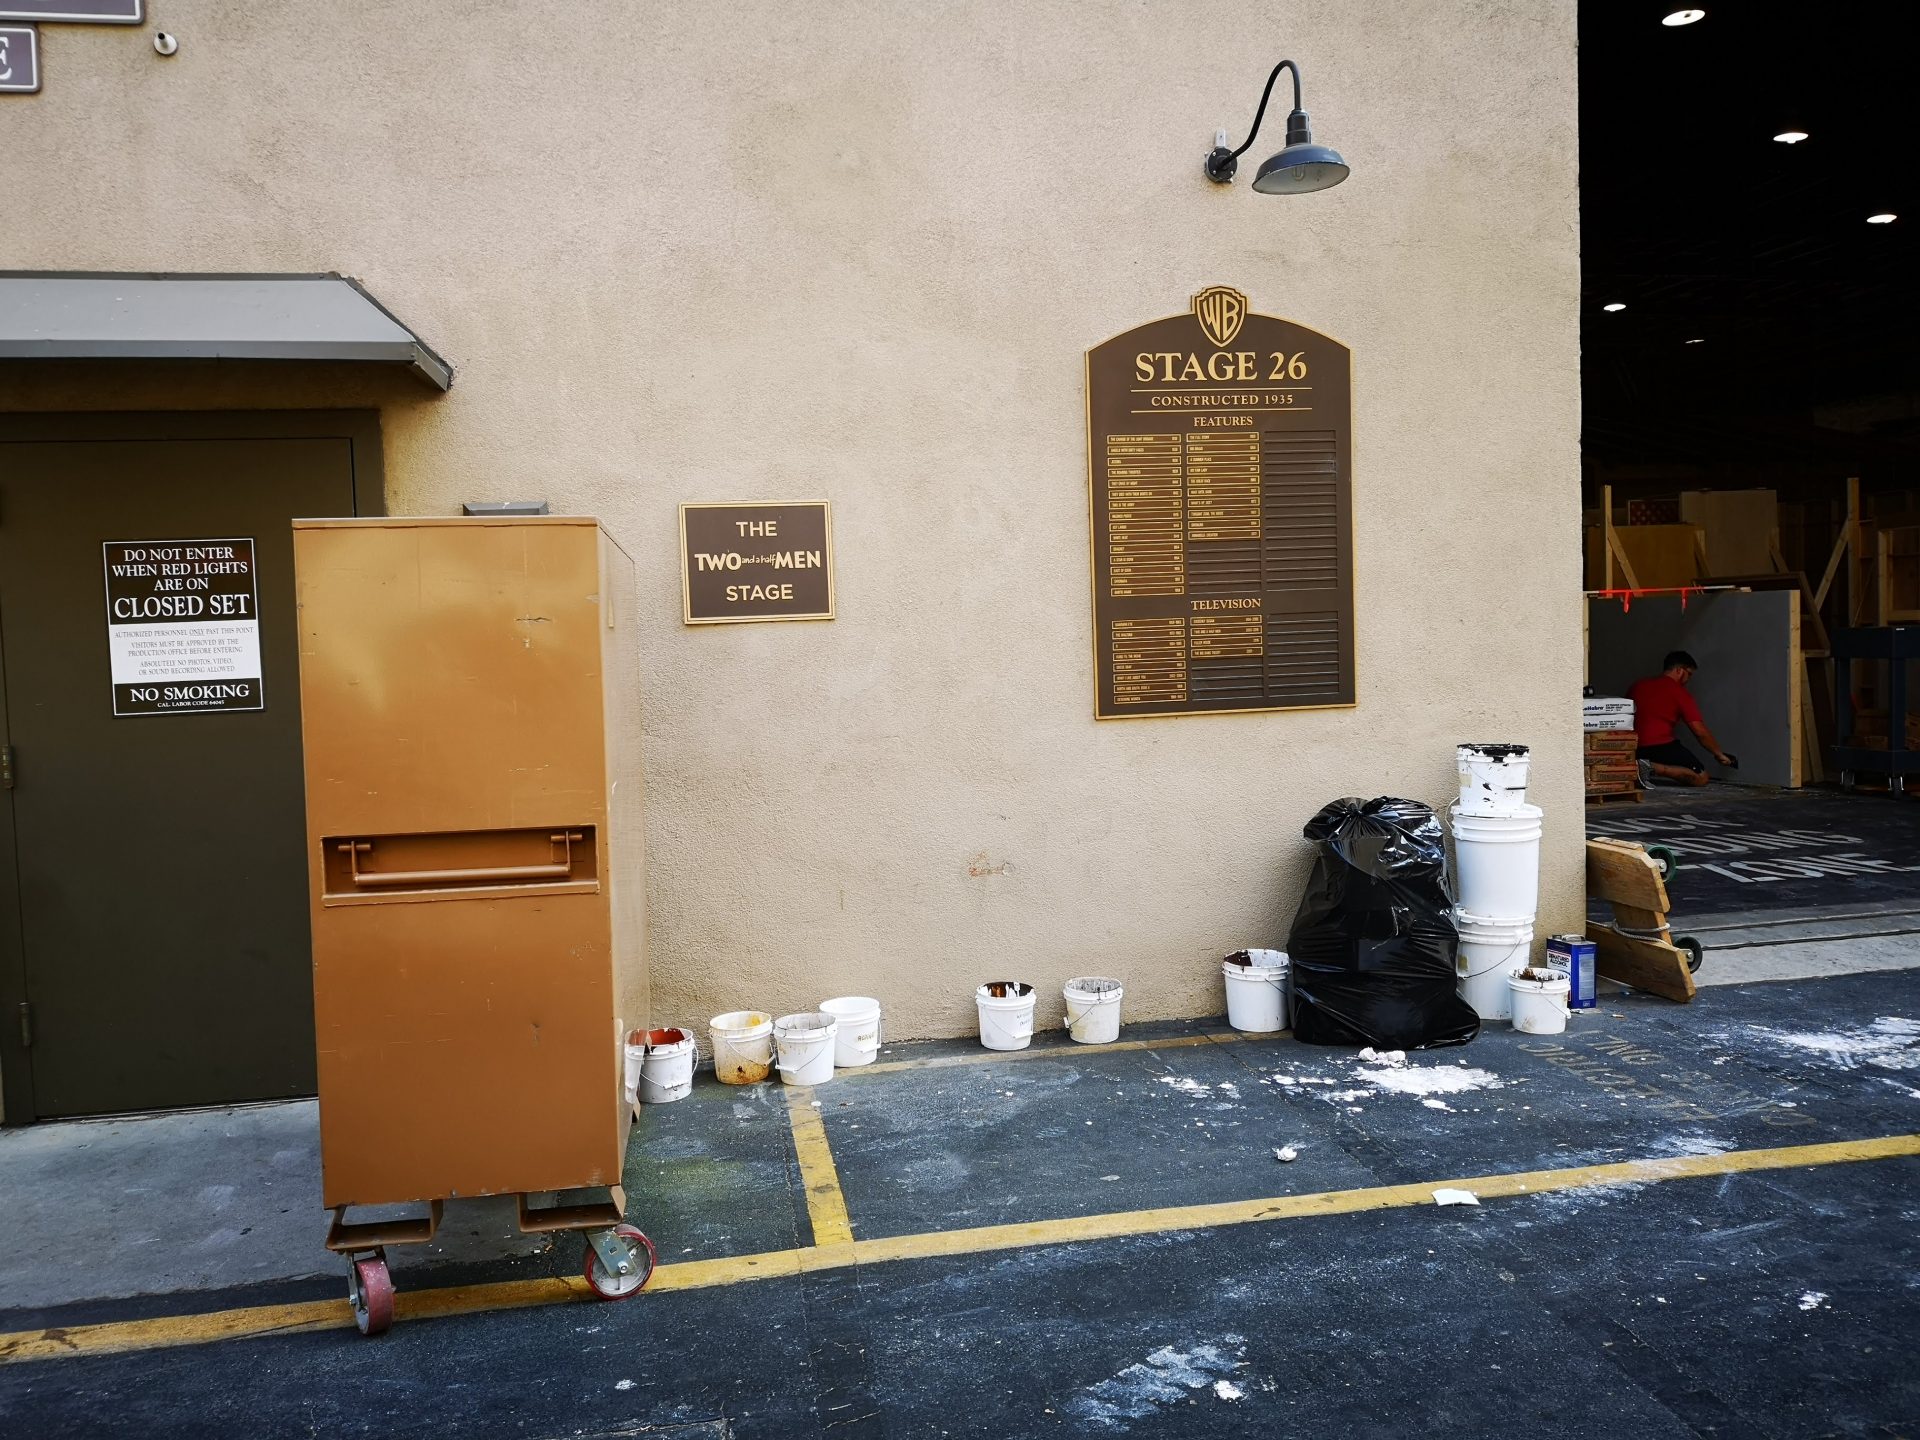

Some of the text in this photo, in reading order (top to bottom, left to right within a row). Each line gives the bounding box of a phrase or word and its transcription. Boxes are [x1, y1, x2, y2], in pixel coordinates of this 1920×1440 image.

[1136, 351, 1307, 382] STAGE 26
[1151, 394, 1293, 407] CONSTRUCTED 1935
[1193, 416, 1253, 427] FEATURES
[736, 521, 777, 537] THE
[124, 547, 234, 561] DO NOT ENTER
[694, 552, 741, 571] TWO
[761, 554, 776, 566] half
[775, 551, 821, 569] MEN
[112, 561, 248, 576] WHEN RED LIGHTS
[154, 578, 208, 591] ARE ON
[726, 584, 794, 601] STAGE
[114, 594, 250, 618] CLOSED SET
[1190, 598, 1262, 610] TELEVISION
[130, 684, 250, 702] NO SMOKING
[1550, 958, 1568, 968] ALCOHOL
